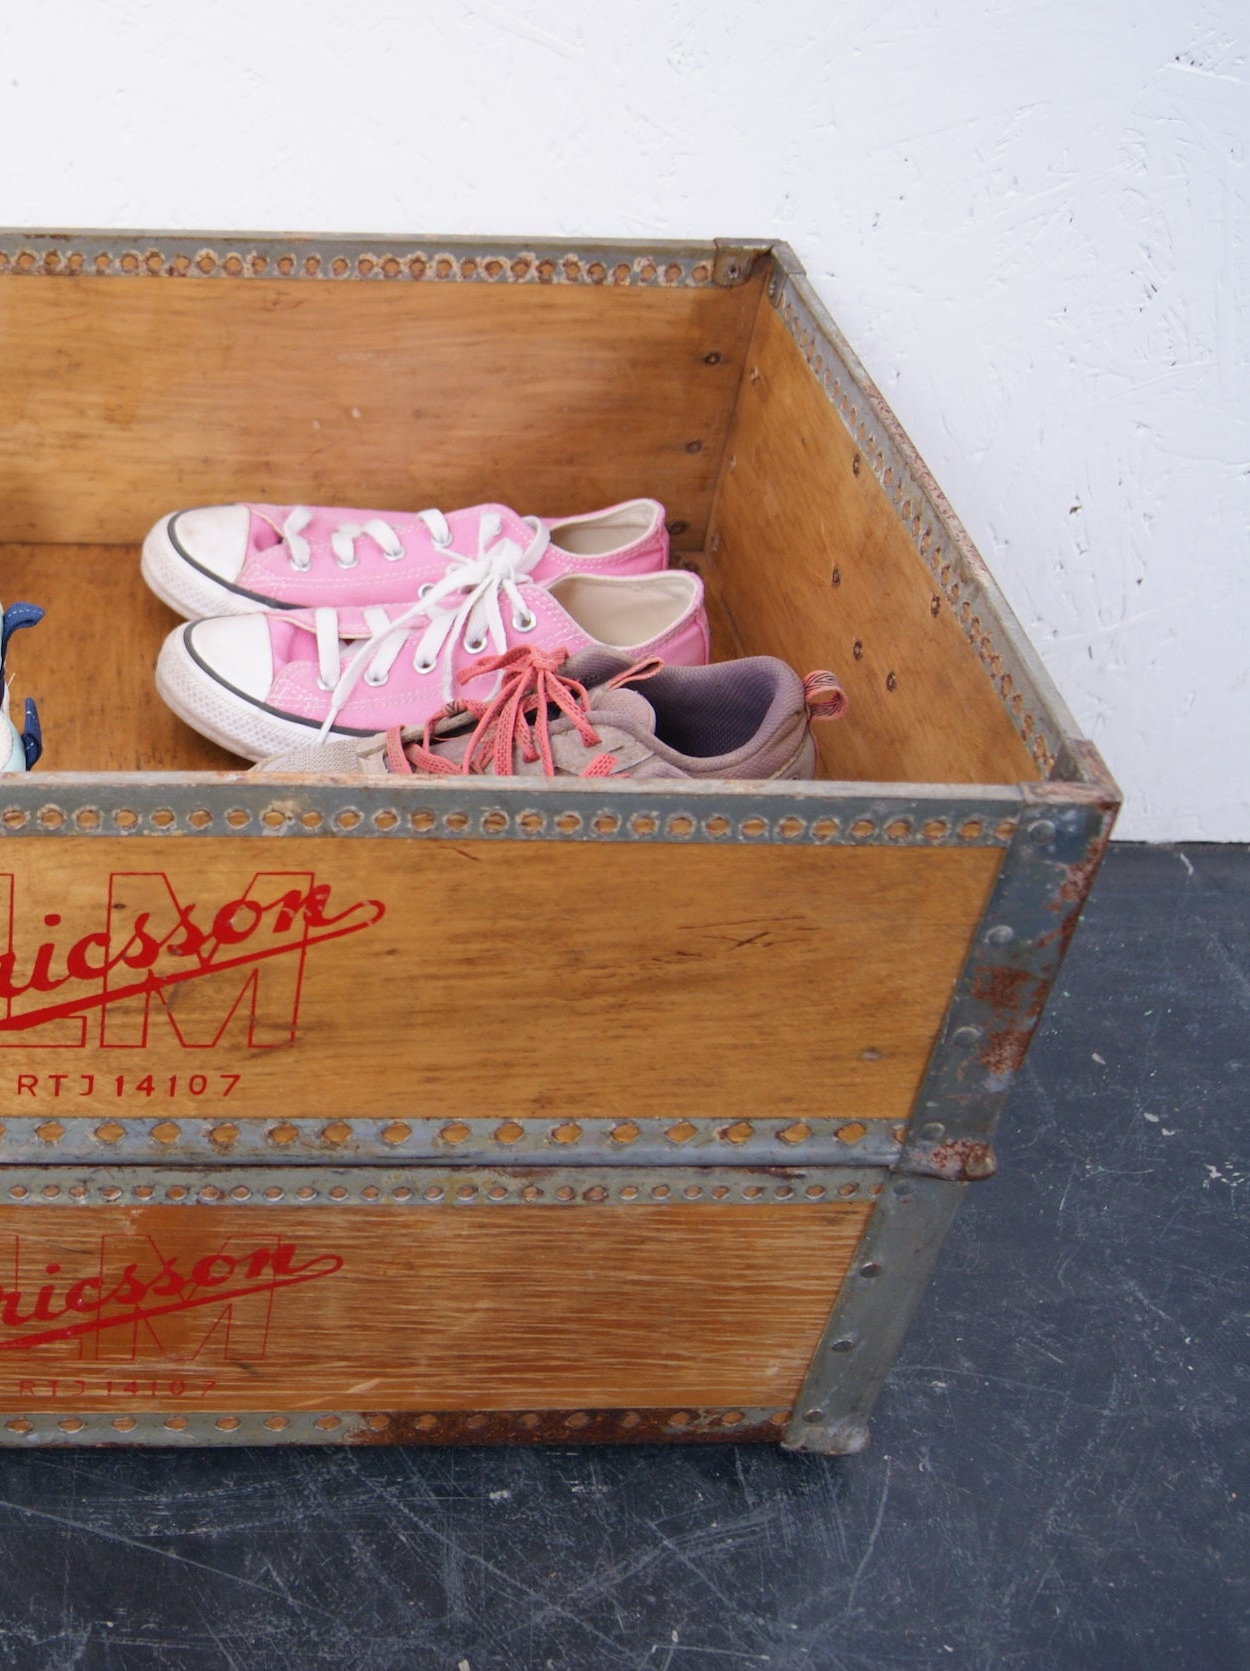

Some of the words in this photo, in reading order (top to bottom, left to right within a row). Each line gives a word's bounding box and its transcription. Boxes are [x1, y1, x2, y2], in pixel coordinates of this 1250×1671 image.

[16, 1074, 95, 1097] RTJ
[115, 1074, 241, 1097] 14107
[105, 1380, 216, 1397] 14107
